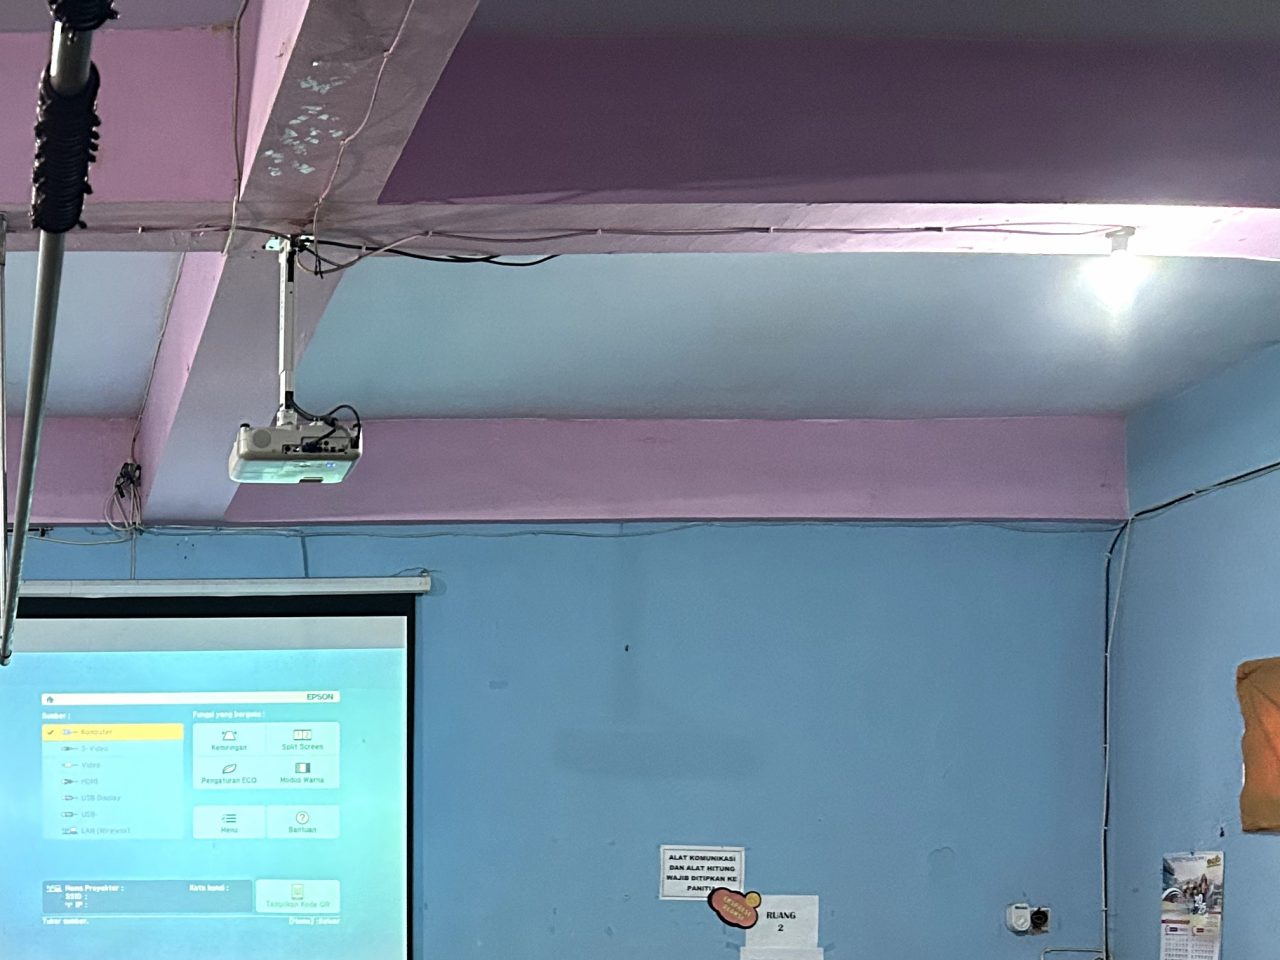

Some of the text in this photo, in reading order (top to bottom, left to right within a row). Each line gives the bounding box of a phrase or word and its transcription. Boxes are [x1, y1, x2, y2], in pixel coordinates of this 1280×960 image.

[306, 692, 334, 701] EPSON
[281, 743, 324, 752] Split Screen
[668, 854, 736, 862] ALAT KOMUNIKASI
[727, 875, 738, 883] KE
[766, 911, 796, 920] RUANG
[777, 924, 784, 932] 2
